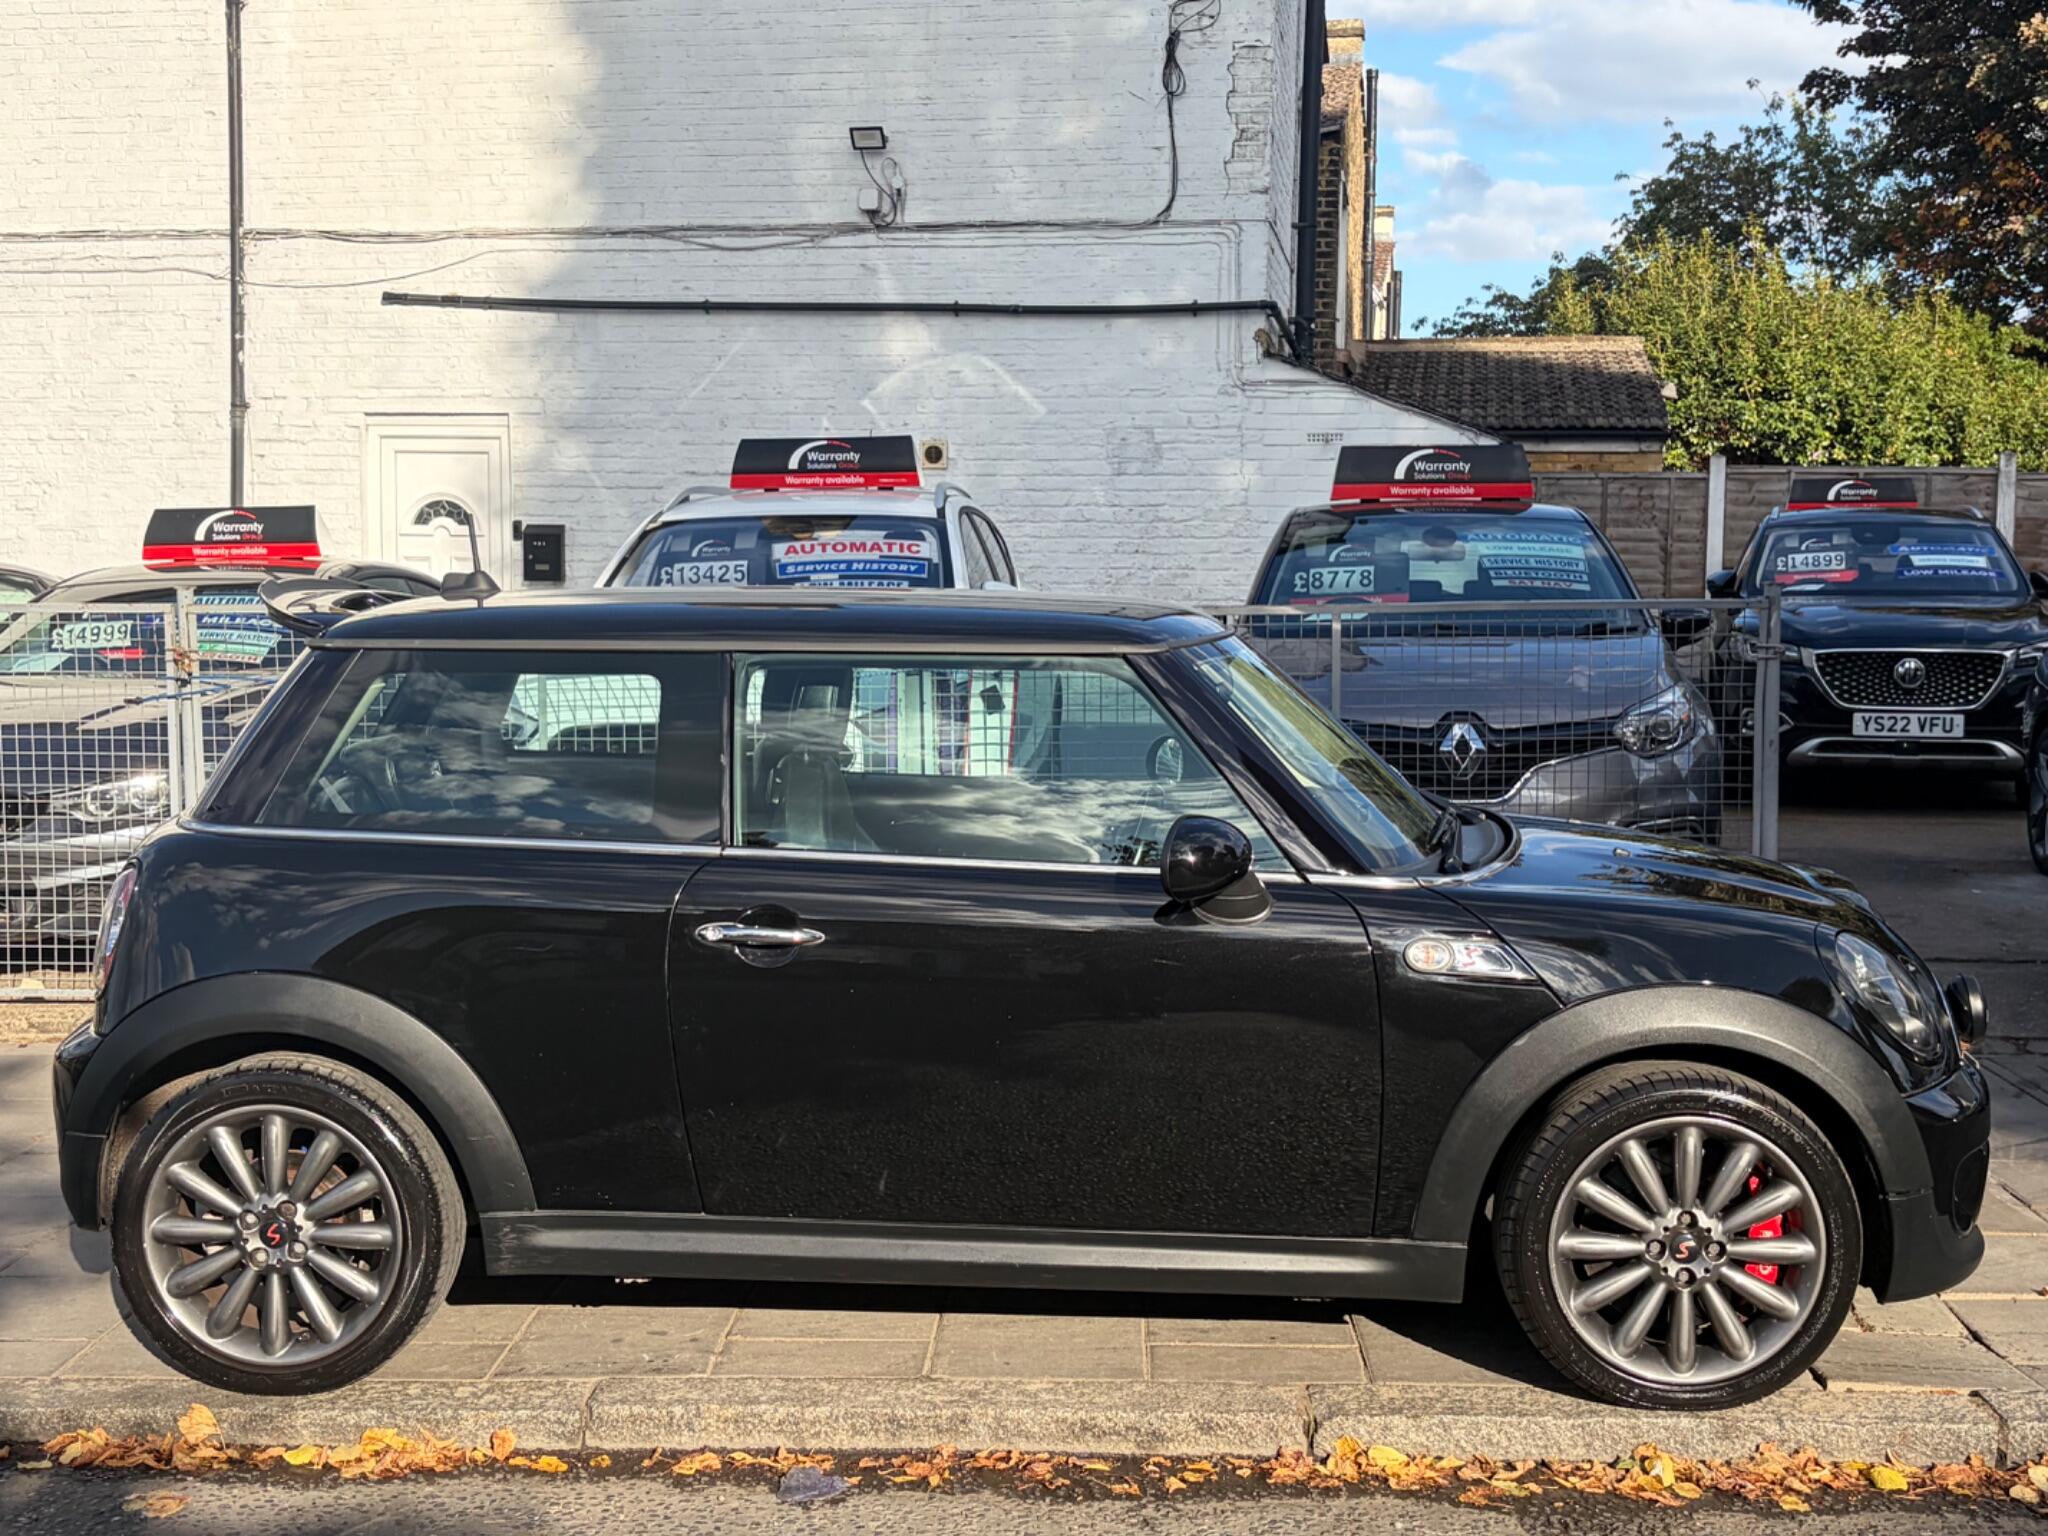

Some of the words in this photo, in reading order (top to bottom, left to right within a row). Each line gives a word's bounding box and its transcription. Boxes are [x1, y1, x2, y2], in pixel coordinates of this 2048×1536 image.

[807, 452, 861, 463] Warranty
[807, 462, 837, 470] Solutions
[1413, 461, 1472, 473] Warranty
[785, 476, 825, 487] Warranty
[825, 475, 865, 485] available
[1390, 486, 1431, 497] Warranty
[1432, 485, 1475, 495] available
[1840, 488, 1879, 497] Warranty
[212, 522, 265, 534] Warranty
[212, 533, 241, 541] Solutions
[192, 546, 230, 557] Warranty
[230, 545, 269, 556] available
[783, 541, 922, 556] AUTOMATIC
[1487, 558, 1529, 567] SERVICE
[1535, 559, 1581, 569] HISTORY
[1777, 553, 1844, 571] £14899
[661, 564, 746, 587] £13425
[1493, 569, 1585, 580] BLUETOOTH
[1294, 569, 1373, 593] £8778
[1507, 579, 1537, 587] SAT
[1540, 580, 1574, 589] NAV
[1861, 715, 1911, 733] YS22
[1917, 716, 1955, 734] VFU
